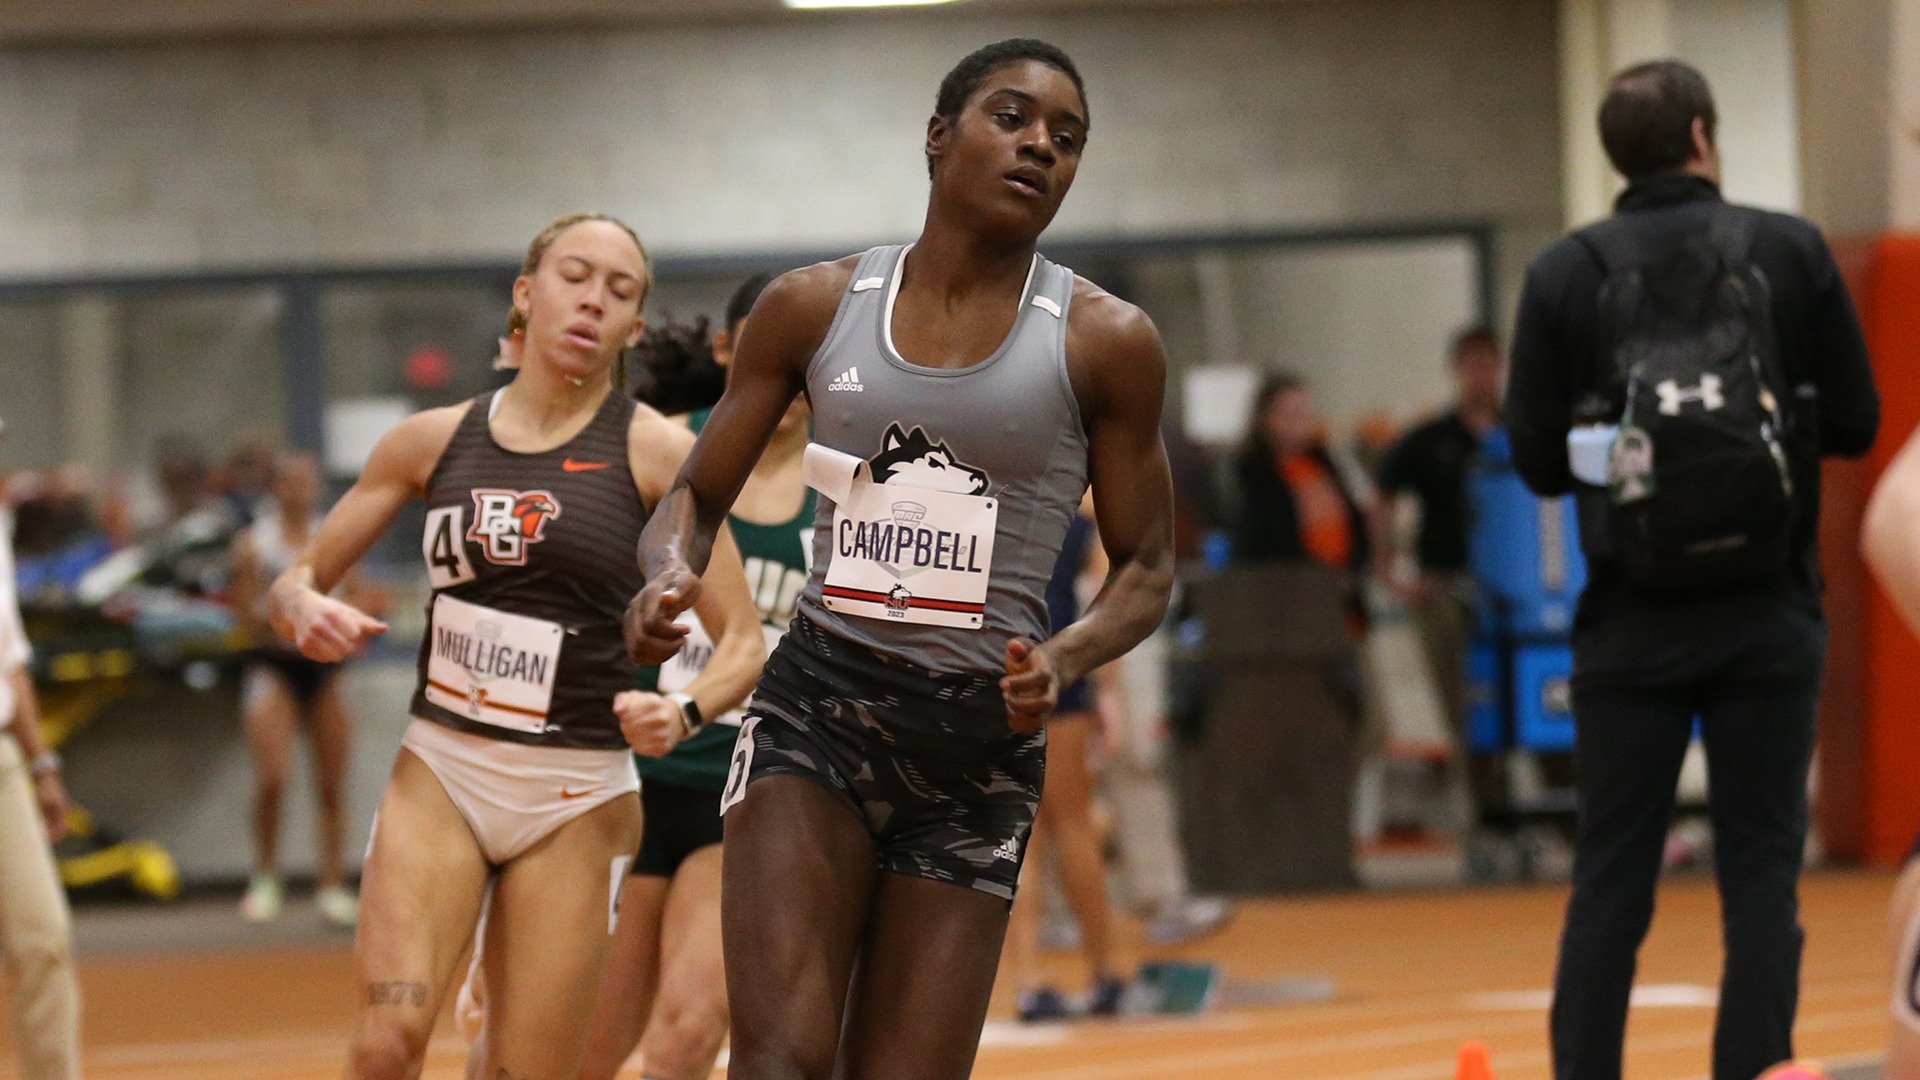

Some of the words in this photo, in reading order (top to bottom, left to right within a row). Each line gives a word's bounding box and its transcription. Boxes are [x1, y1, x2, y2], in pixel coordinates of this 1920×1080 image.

[828, 381, 864, 392] adidas
[431, 513, 460, 578] 4
[474, 493, 521, 560] BG
[839, 518, 982, 573] CAMPBELL
[437, 626, 547, 686] MULLIGAN
